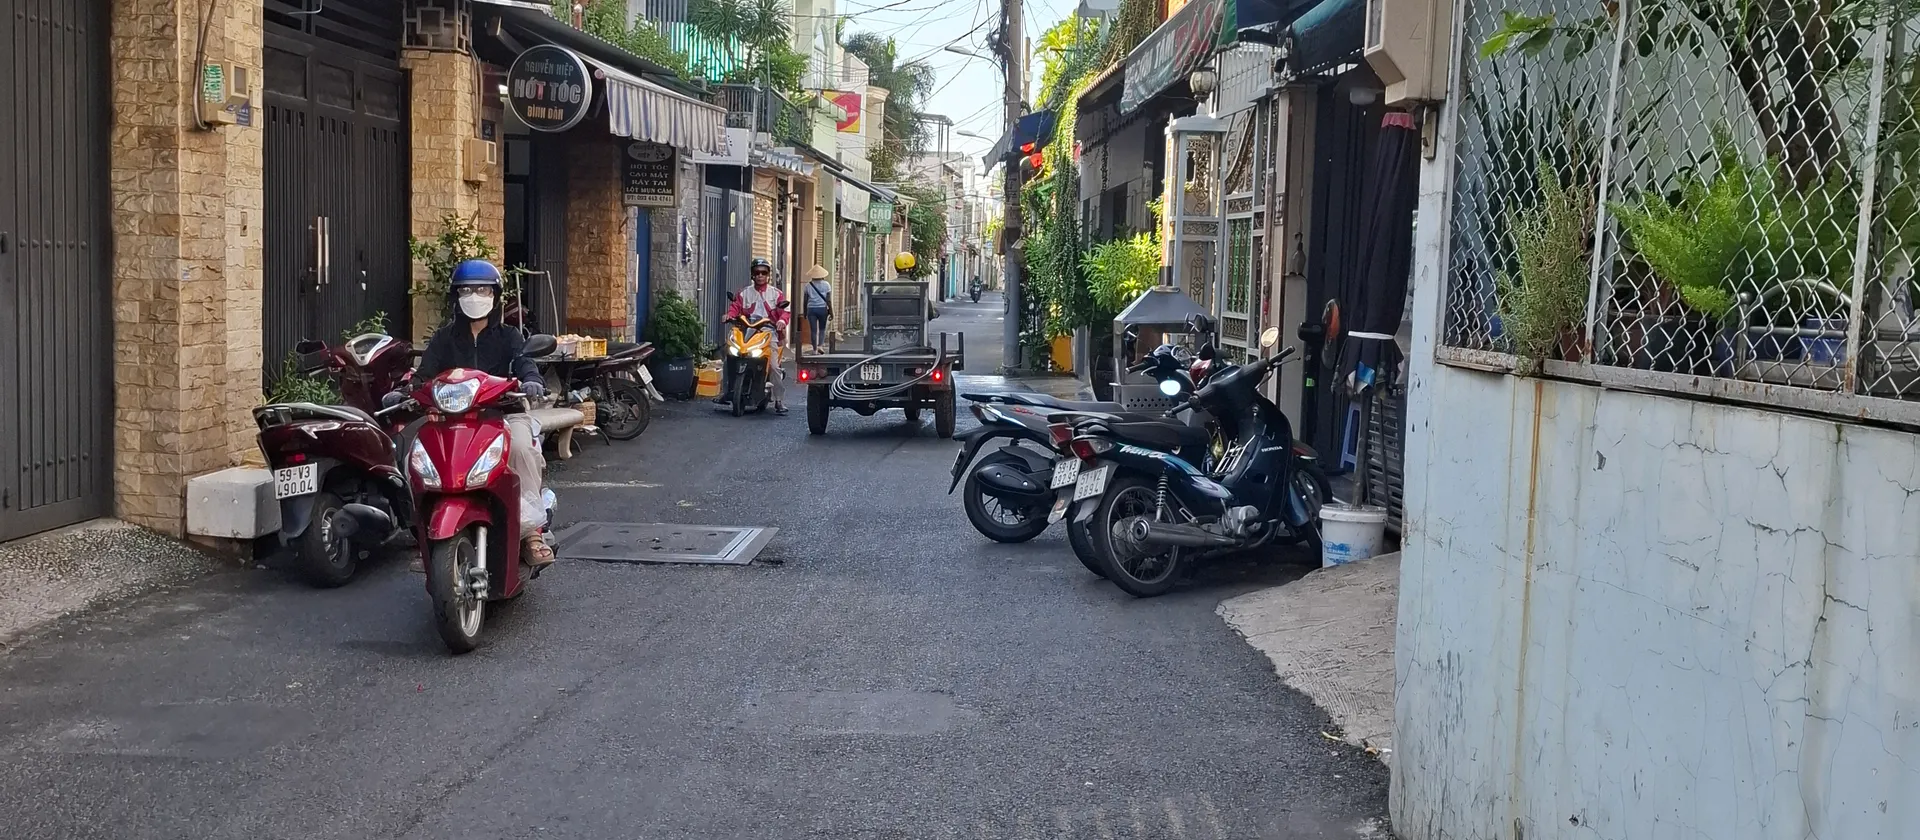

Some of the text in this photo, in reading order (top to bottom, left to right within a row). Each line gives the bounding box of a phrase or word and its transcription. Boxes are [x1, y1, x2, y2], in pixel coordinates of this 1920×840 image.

[514, 77, 581, 104] HỚT TÓC
[527, 104, 546, 119] BÌNH
[280, 466, 311, 482] 59-V3
[278, 479, 313, 497] 490.04
